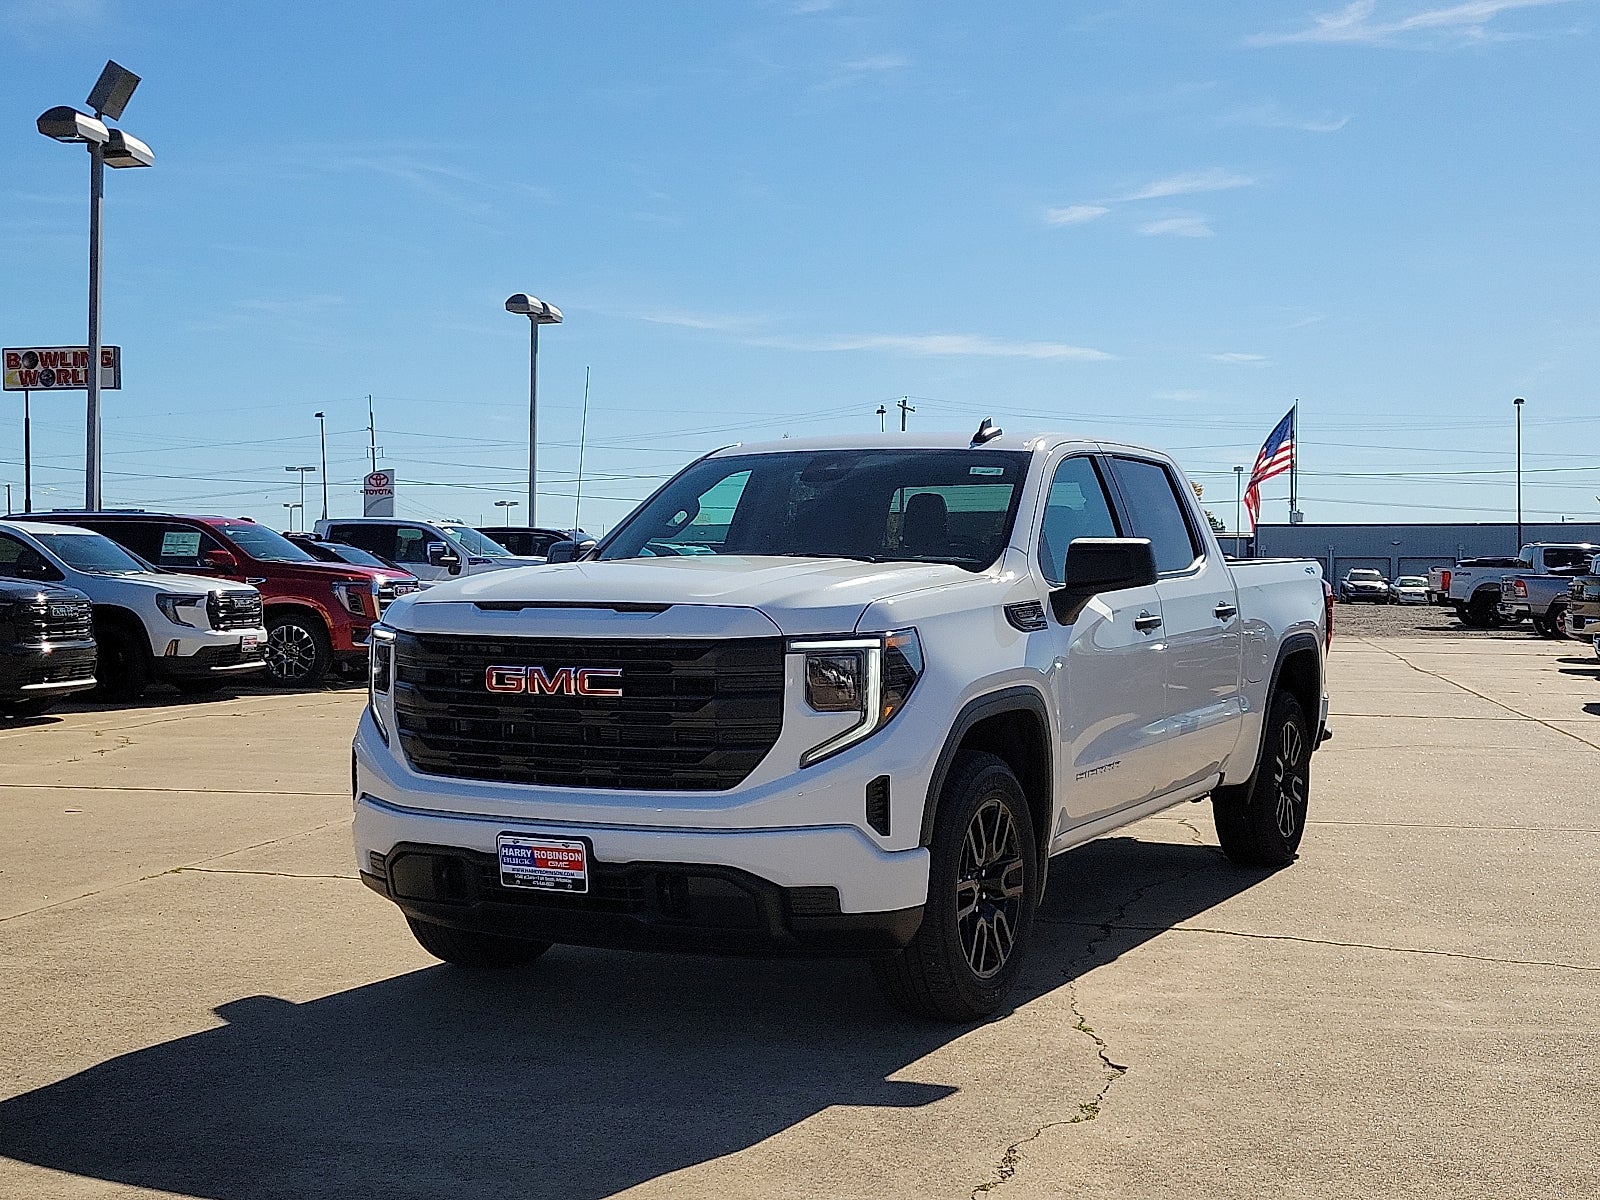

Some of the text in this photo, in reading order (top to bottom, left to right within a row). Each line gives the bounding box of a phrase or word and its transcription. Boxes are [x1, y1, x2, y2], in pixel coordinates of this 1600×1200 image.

[486, 666, 622, 696] GMC
[502, 848, 582, 861] HARRY ROBINSON
[503, 857, 531, 865] BUICK
